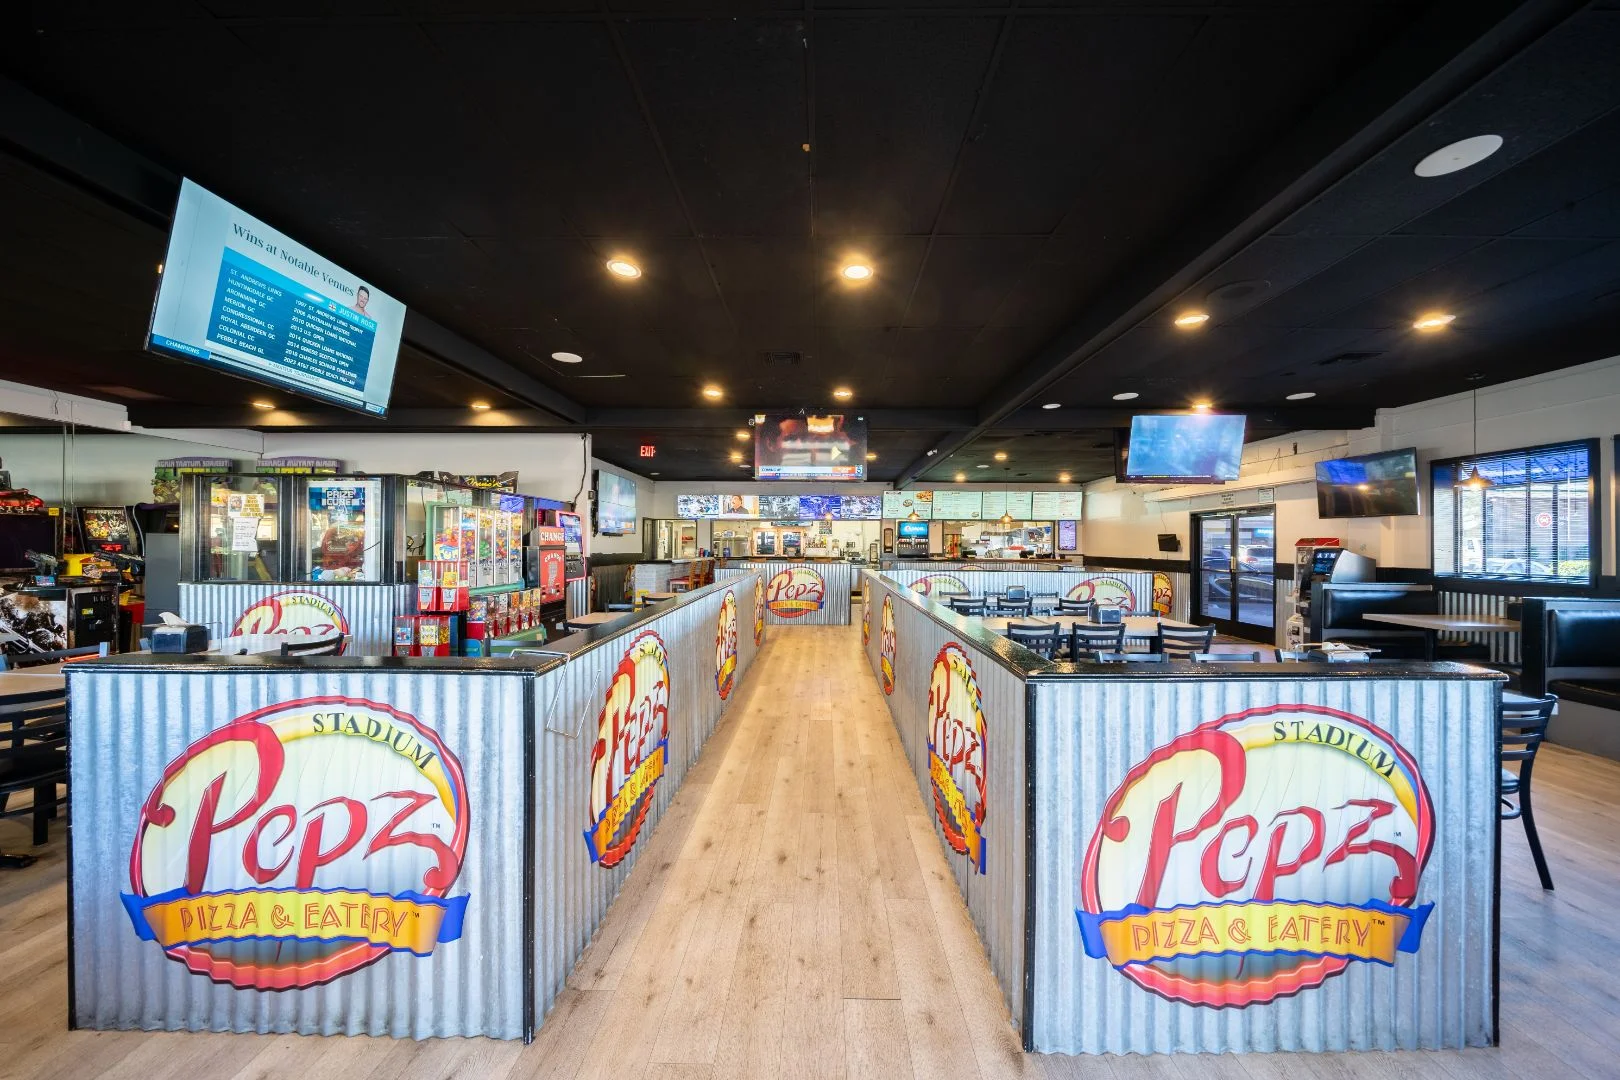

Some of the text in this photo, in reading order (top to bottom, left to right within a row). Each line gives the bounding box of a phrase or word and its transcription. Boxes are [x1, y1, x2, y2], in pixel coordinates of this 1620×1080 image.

[232, 222, 354, 296] Wins at Notable Venues
[228, 277, 274, 302] HUNTINGDALE GC
[240, 273, 266, 290] ANDREWS
[267, 285, 282, 297] LINKS
[223, 295, 255, 313] MERION GC
[258, 300, 266, 308] GC
[315, 308, 336, 322] ANDREWS
[220, 314, 239, 326] ROYAL
[239, 321, 267, 336] ABERDEEN
[222, 304, 266, 327] CONGRESSIONAL
[306, 313, 332, 328] AUSTRALIAN
[338, 306, 375, 329] JUSTIN ROSE
[218, 323, 246, 338] COLONIAL
[290, 323, 302, 333] 2013
[291, 315, 304, 325] 2010
[324, 329, 337, 339] LOANS
[165, 339, 200, 355] CHAMPIONS
[216, 332, 237, 344] PEBBLE
[238, 340, 256, 351] BEACH
[288, 331, 301, 341] 2014
[321, 344, 335, 354] LOANS
[298, 353, 317, 364] CHARLES
[338, 359, 349, 367] OPEN
[309, 365, 325, 375] PEBBLE
[325, 371, 338, 379] BEACH
[640, 445, 655, 457] EXIT
[326, 489, 355, 499] PRIZE
[767, 570, 823, 602] Pepz
[313, 712, 437, 771] STADIUM
[1273, 720, 1398, 779] STADIUM
[146, 721, 459, 895] Pepz
[1102, 729, 1418, 908] Pepz
[180, 901, 260, 934] PIZZA
[270, 902, 295, 930] &
[303, 902, 409, 938] EATERY
[1132, 917, 1219, 951] PIZZA
[1227, 918, 1252, 945] &
[1268, 916, 1371, 947] EATERY
